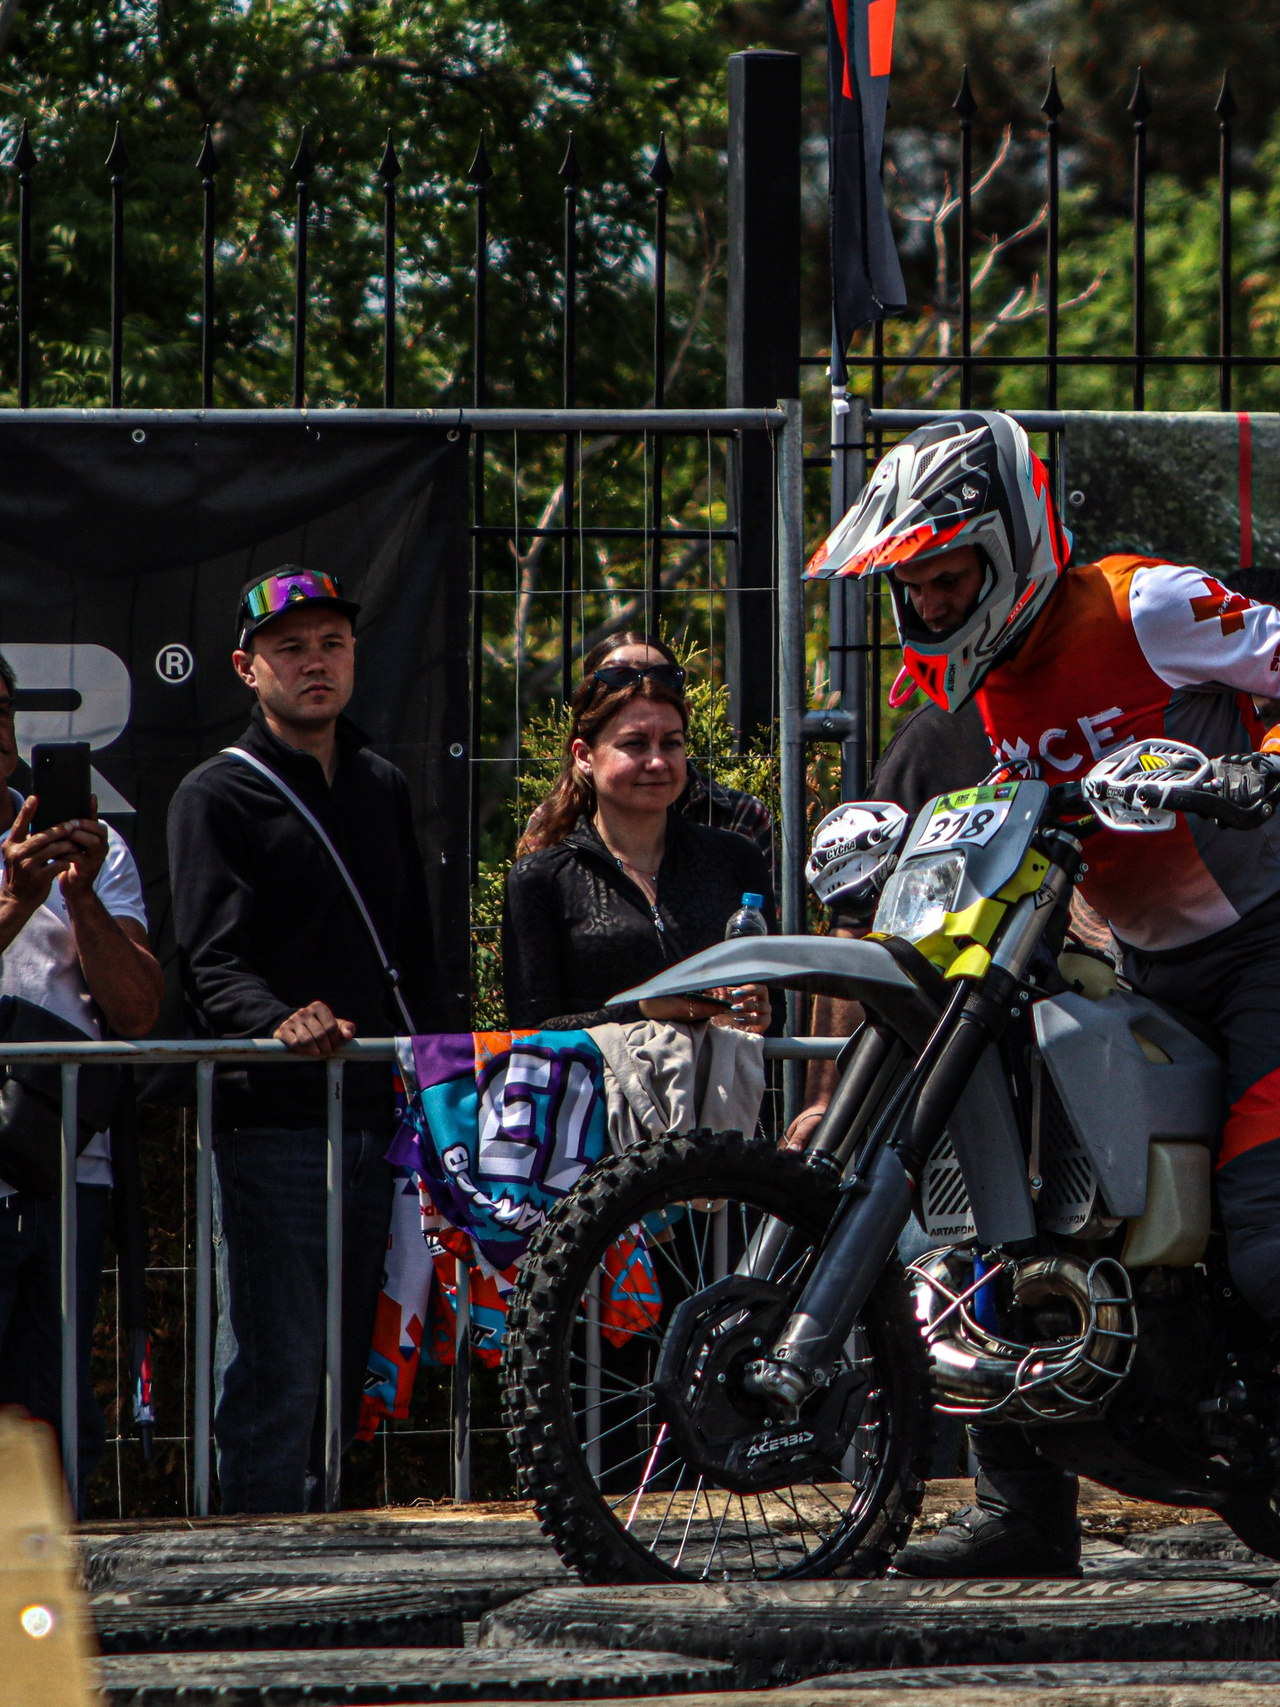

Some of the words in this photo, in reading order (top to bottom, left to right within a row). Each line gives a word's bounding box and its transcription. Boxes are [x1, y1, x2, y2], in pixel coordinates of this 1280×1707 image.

[1107, 786, 1126, 800] CYCRA
[917, 808, 996, 847] 318
[826, 840, 857, 861] CYCRA
[930, 1225, 975, 1237] ARTAFON
